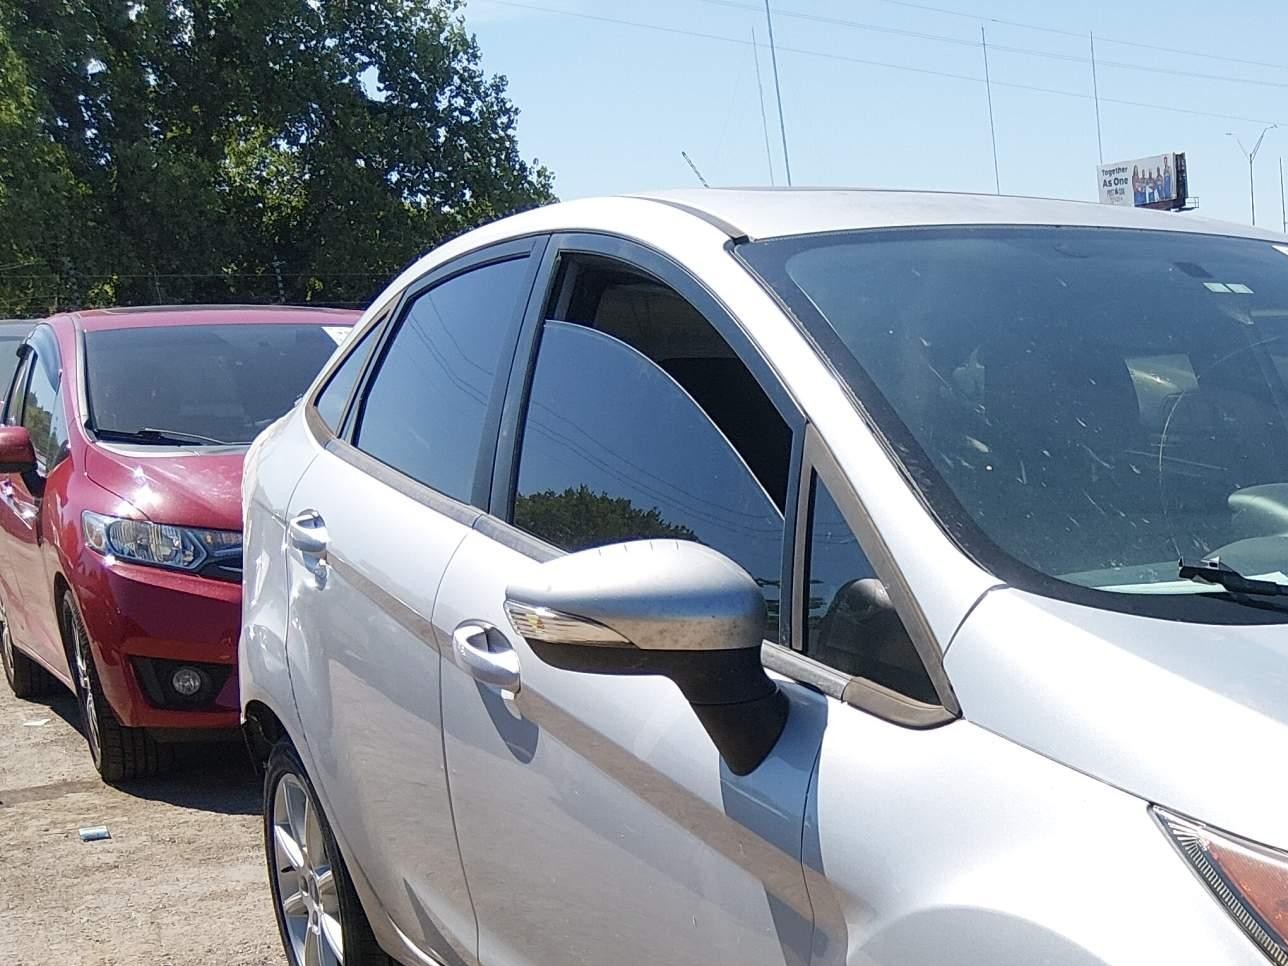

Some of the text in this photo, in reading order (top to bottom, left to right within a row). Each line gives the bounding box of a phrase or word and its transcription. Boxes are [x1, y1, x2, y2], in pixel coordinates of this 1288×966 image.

[1101, 166, 1128, 177] Together
[1102, 177, 1129, 188] As One
